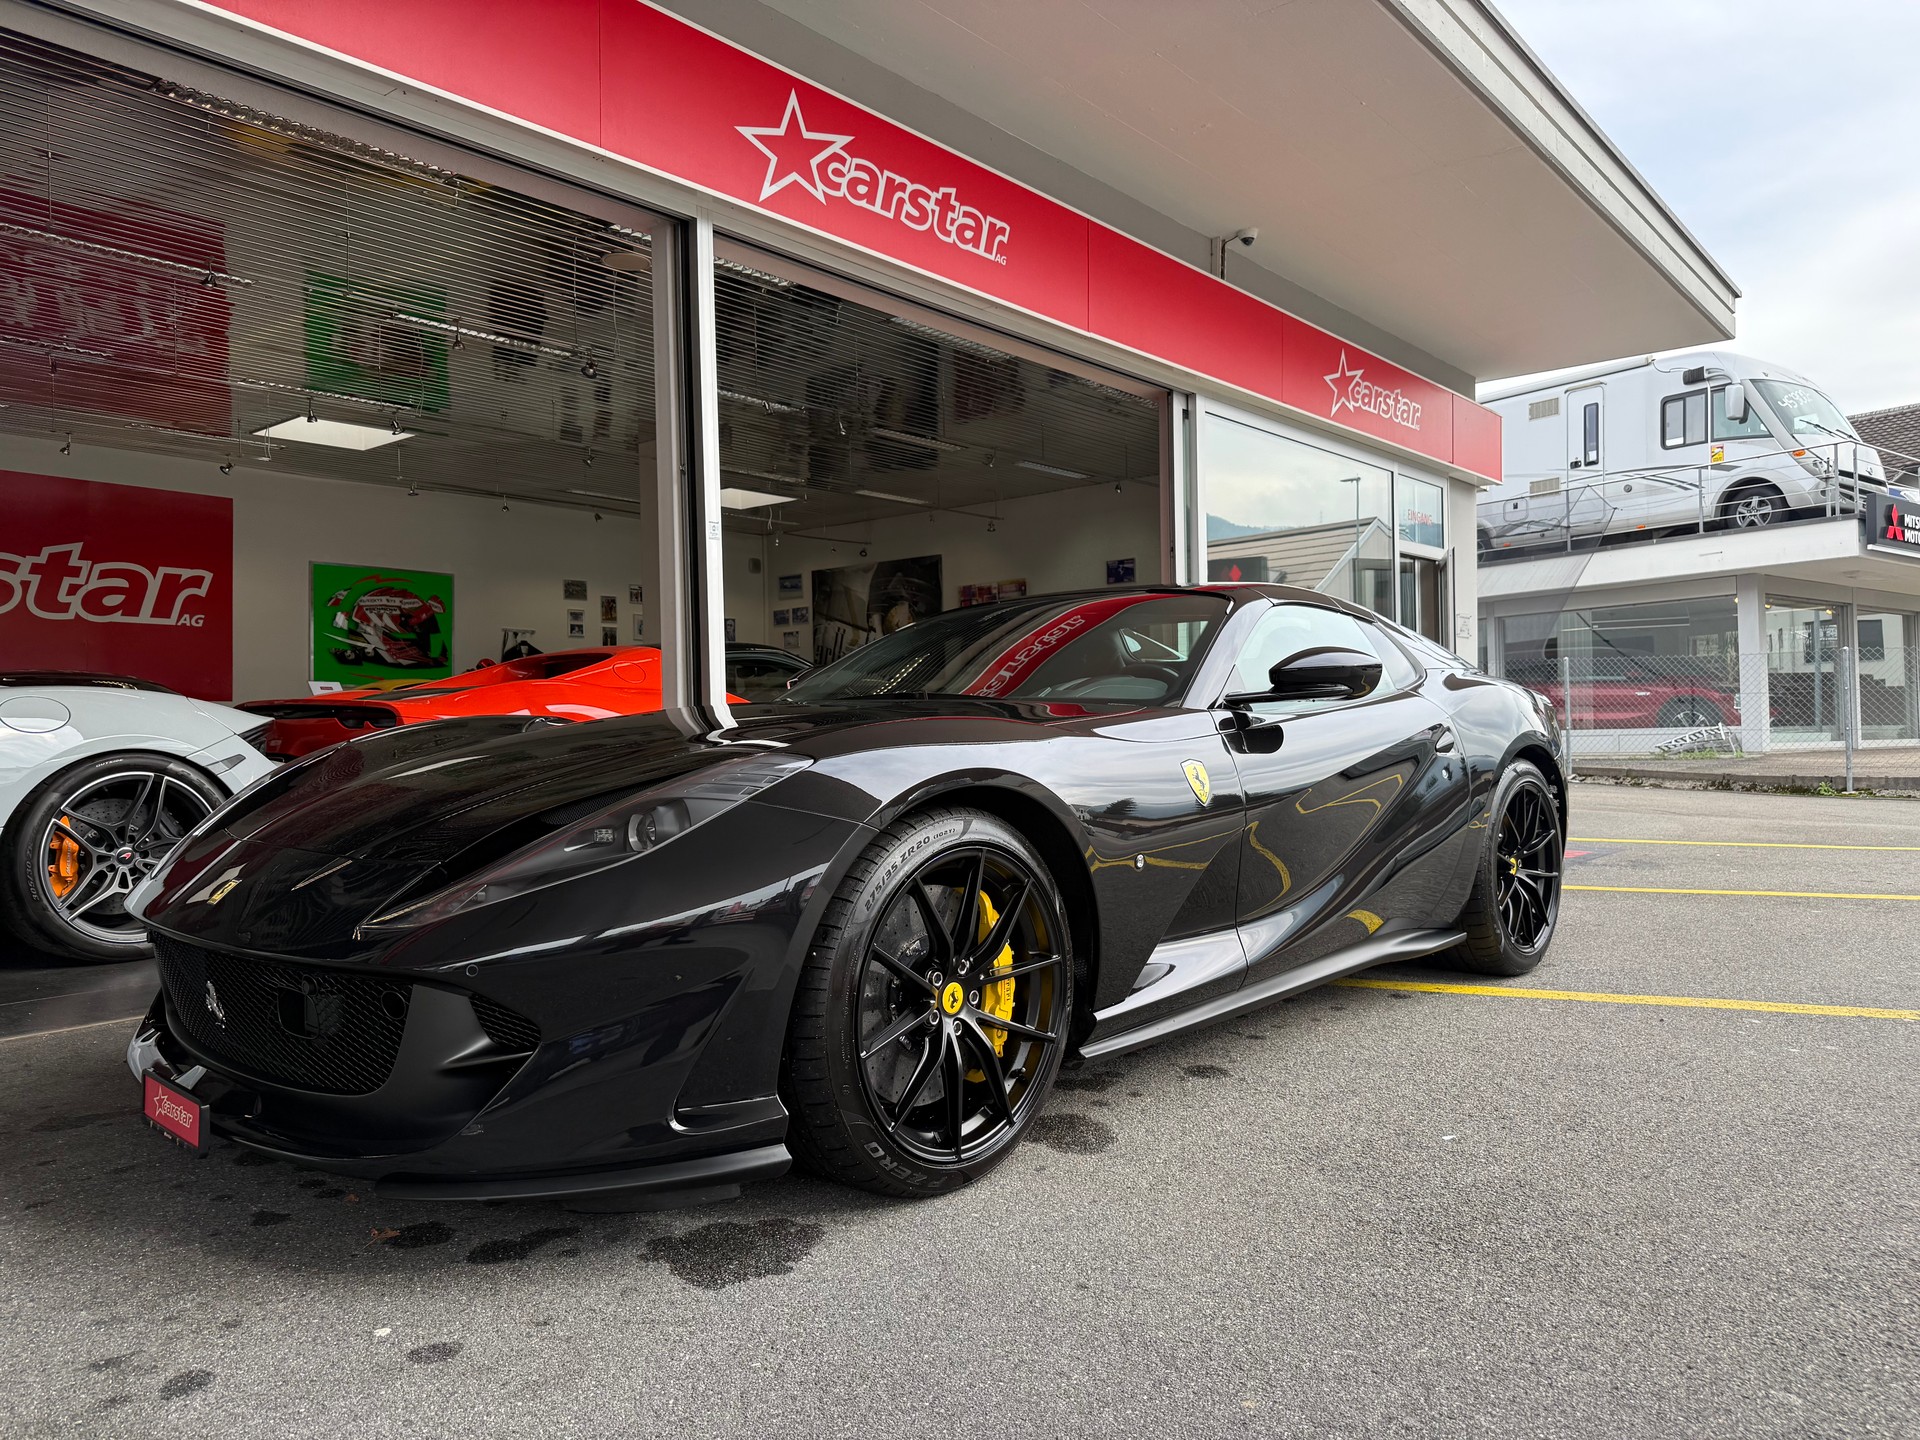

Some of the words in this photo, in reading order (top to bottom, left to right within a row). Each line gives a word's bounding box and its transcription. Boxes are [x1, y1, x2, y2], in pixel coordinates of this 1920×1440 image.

[814, 147, 1011, 261] carstar
[995, 253, 1007, 266] AG
[1349, 379, 1421, 429] carstar
[1407, 508, 1433, 527] EINGANG
[177, 613, 206, 627] AG
[864, 862, 899, 912] 275/35
[899, 836, 931, 864] ZR20
[933, 827, 956, 840] (102Y)
[162, 1101, 194, 1128] carstar
